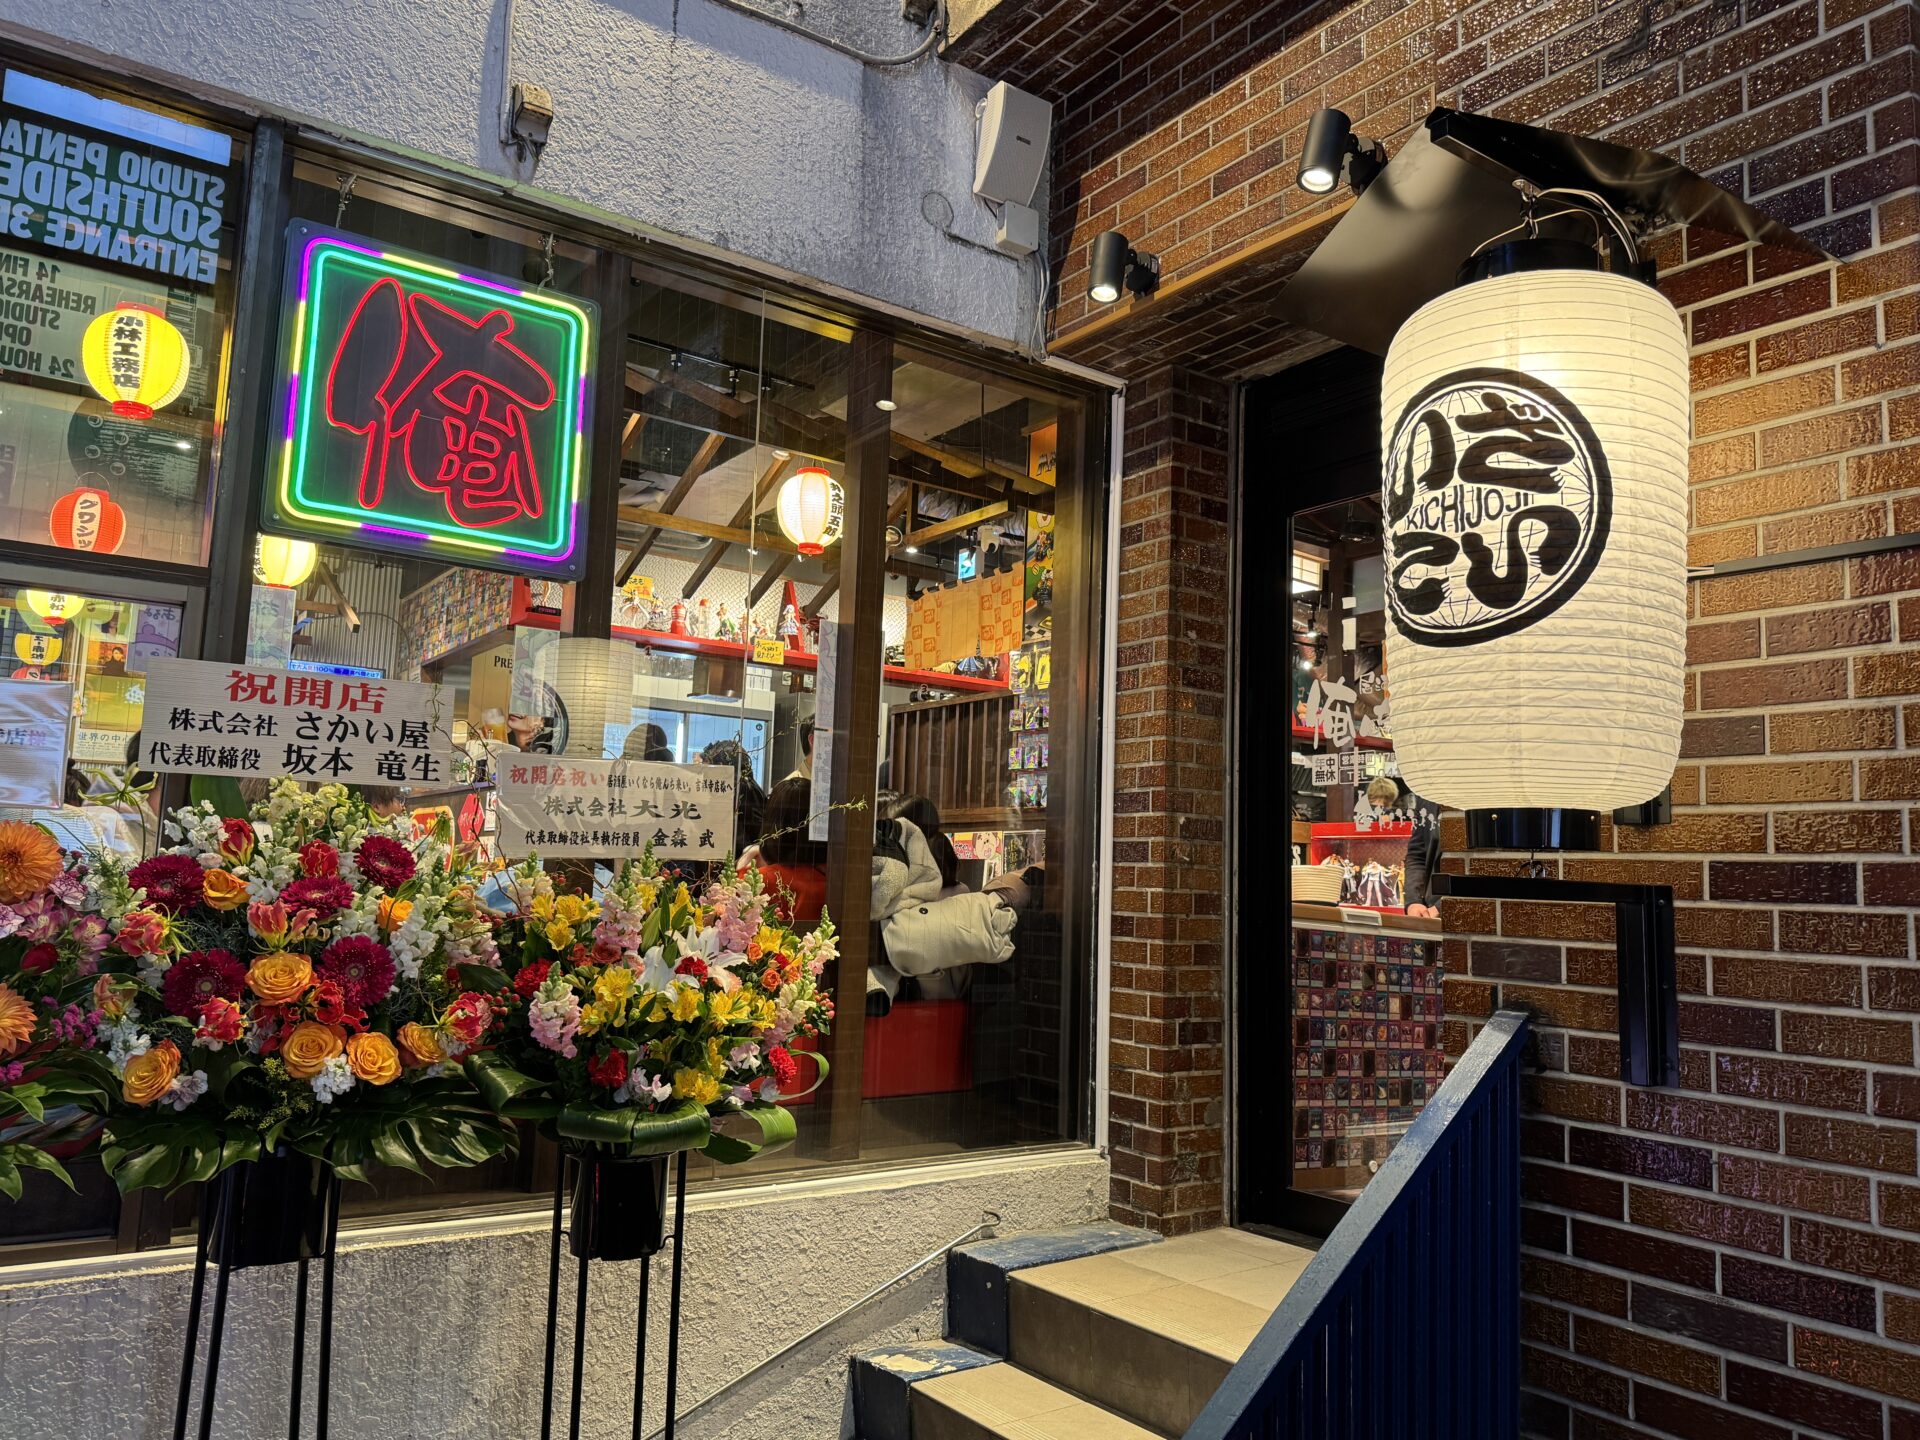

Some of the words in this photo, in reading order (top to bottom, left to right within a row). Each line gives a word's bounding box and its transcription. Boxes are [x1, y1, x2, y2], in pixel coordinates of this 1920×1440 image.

[1405, 484, 1530, 533] KICHIJOJI
[224, 670, 389, 714] 祝開店
[78, 731, 127, 743] 世界の中
[168, 707, 279, 738] 株式会社
[295, 711, 431, 750] さかい屋
[148, 741, 262, 771] 代表取締役
[282, 743, 354, 777] 坂本
[375, 750, 441, 783] 竜生
[508, 763, 606, 788] 祝開店祝い
